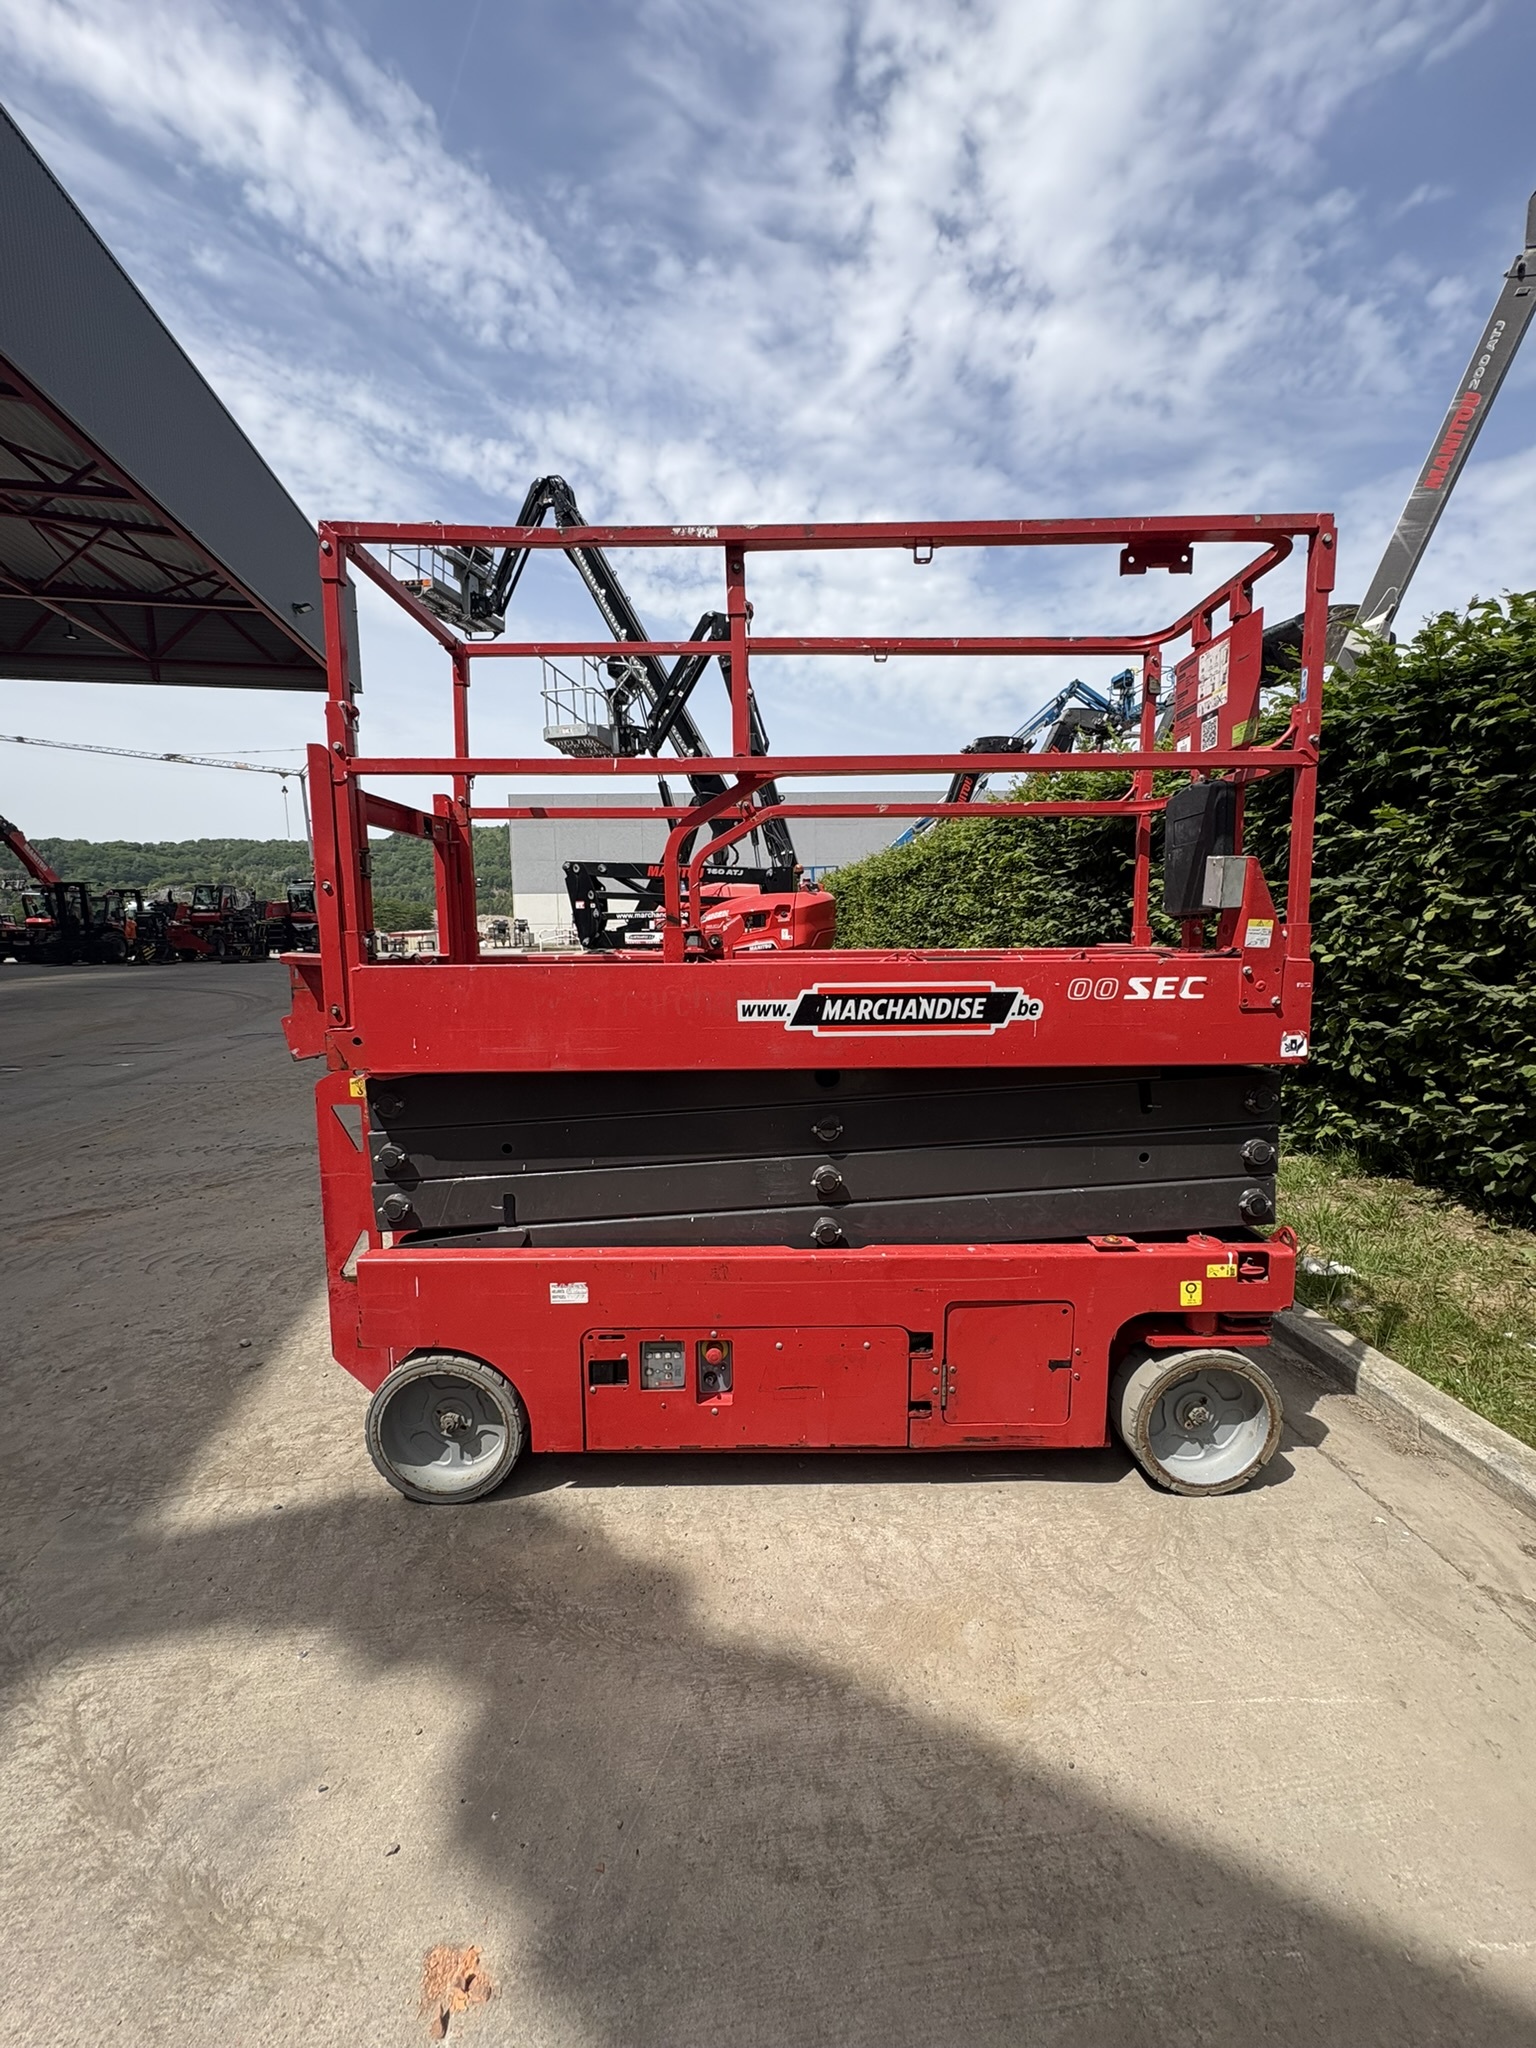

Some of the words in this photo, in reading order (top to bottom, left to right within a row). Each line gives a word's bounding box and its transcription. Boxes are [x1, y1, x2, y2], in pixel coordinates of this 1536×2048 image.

[1424, 391, 1482, 489] MANITOU
[1468, 354, 1491, 390] 200
[1486, 320, 1506, 351] ATJ
[726, 868, 744, 876] ATJ
[1123, 976, 1208, 1000] SEC
[821, 998, 987, 1021] MARCHANDISE
